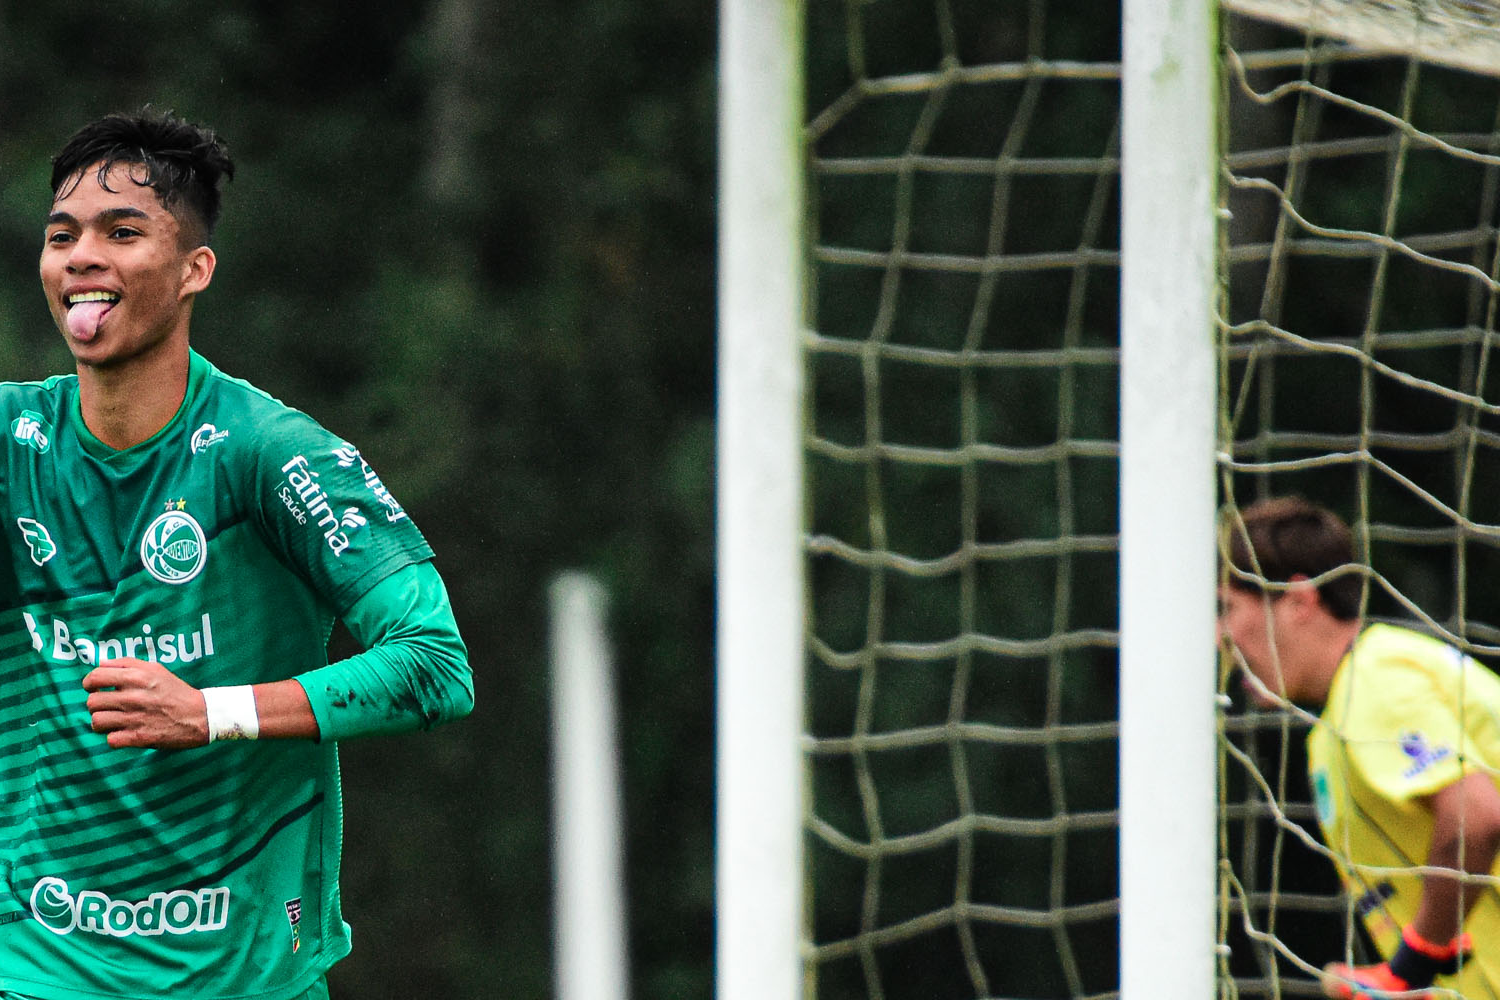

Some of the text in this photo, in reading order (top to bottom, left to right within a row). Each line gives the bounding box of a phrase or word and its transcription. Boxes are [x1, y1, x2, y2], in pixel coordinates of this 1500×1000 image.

[15, 417, 48, 449] life
[278, 487, 307, 526] Saúde
[282, 455, 349, 557] fátima
[167, 541, 198, 559] JUVENTUDE
[52, 613, 214, 666] Banrisul
[77, 887, 230, 937] RodOil
